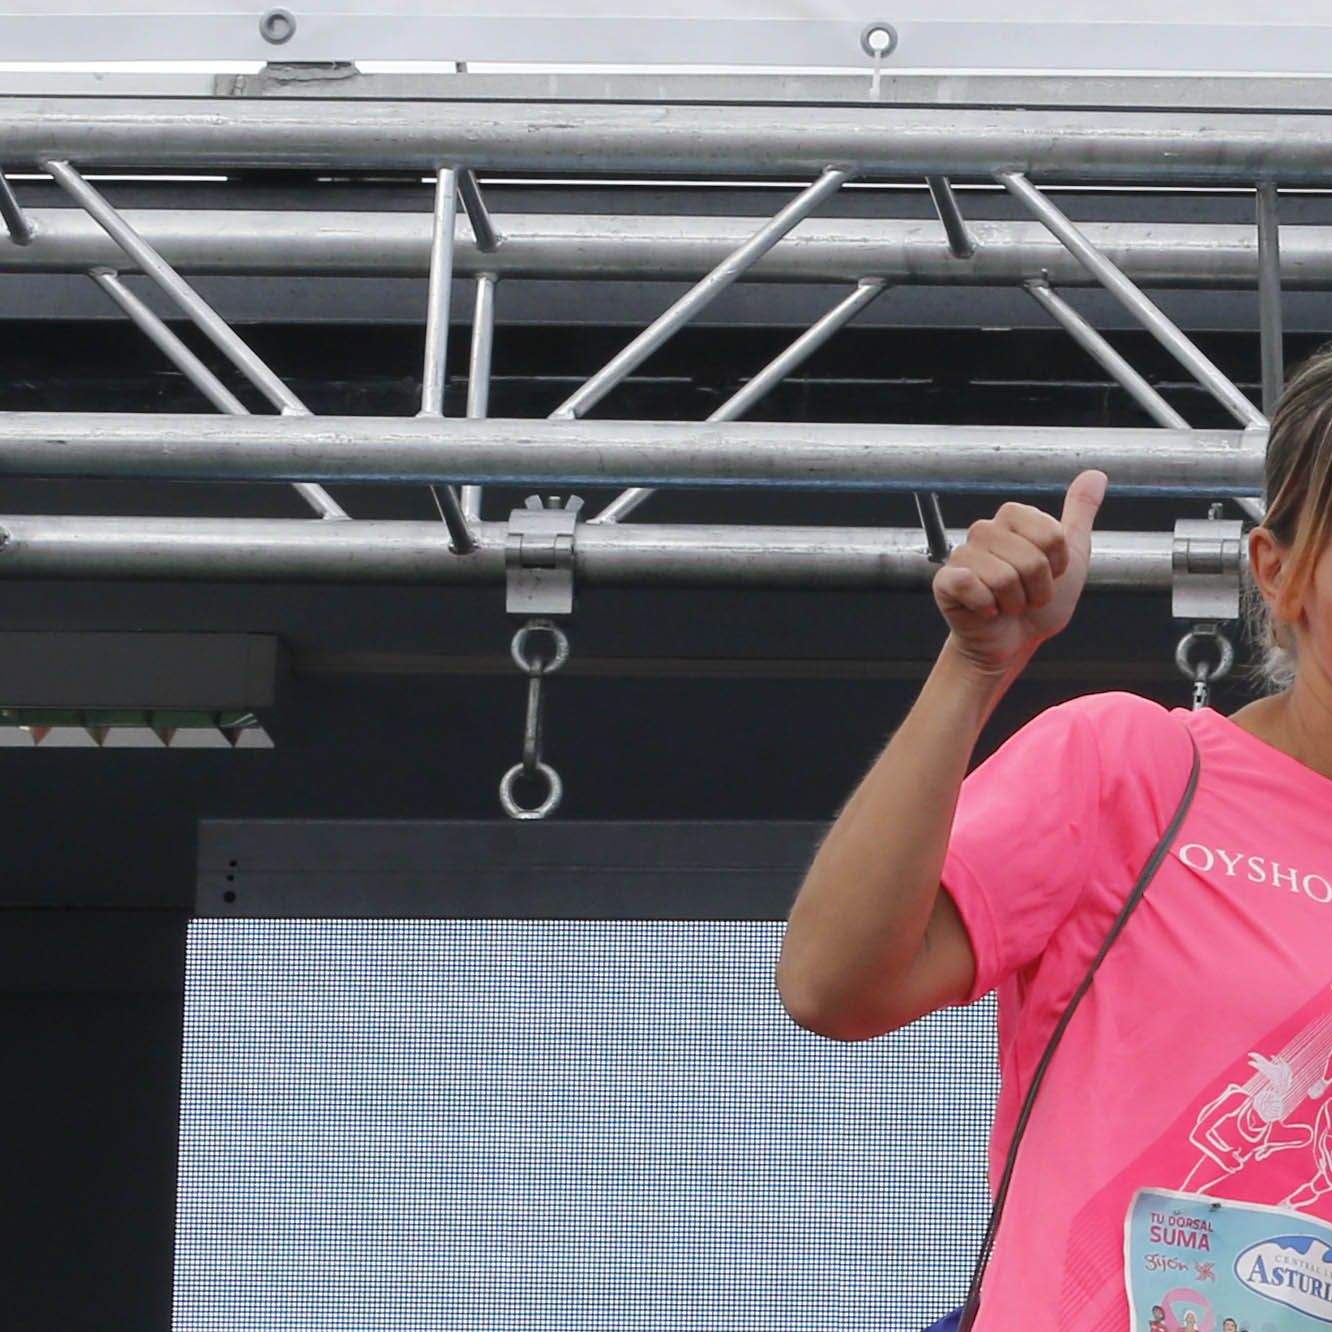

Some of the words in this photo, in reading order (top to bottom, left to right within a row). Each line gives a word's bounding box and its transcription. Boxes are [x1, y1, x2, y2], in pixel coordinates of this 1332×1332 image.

[1152, 1213, 1165, 1225] TU
[1169, 1215, 1213, 1233] DORSAL
[1151, 1226, 1210, 1251] SUMA
